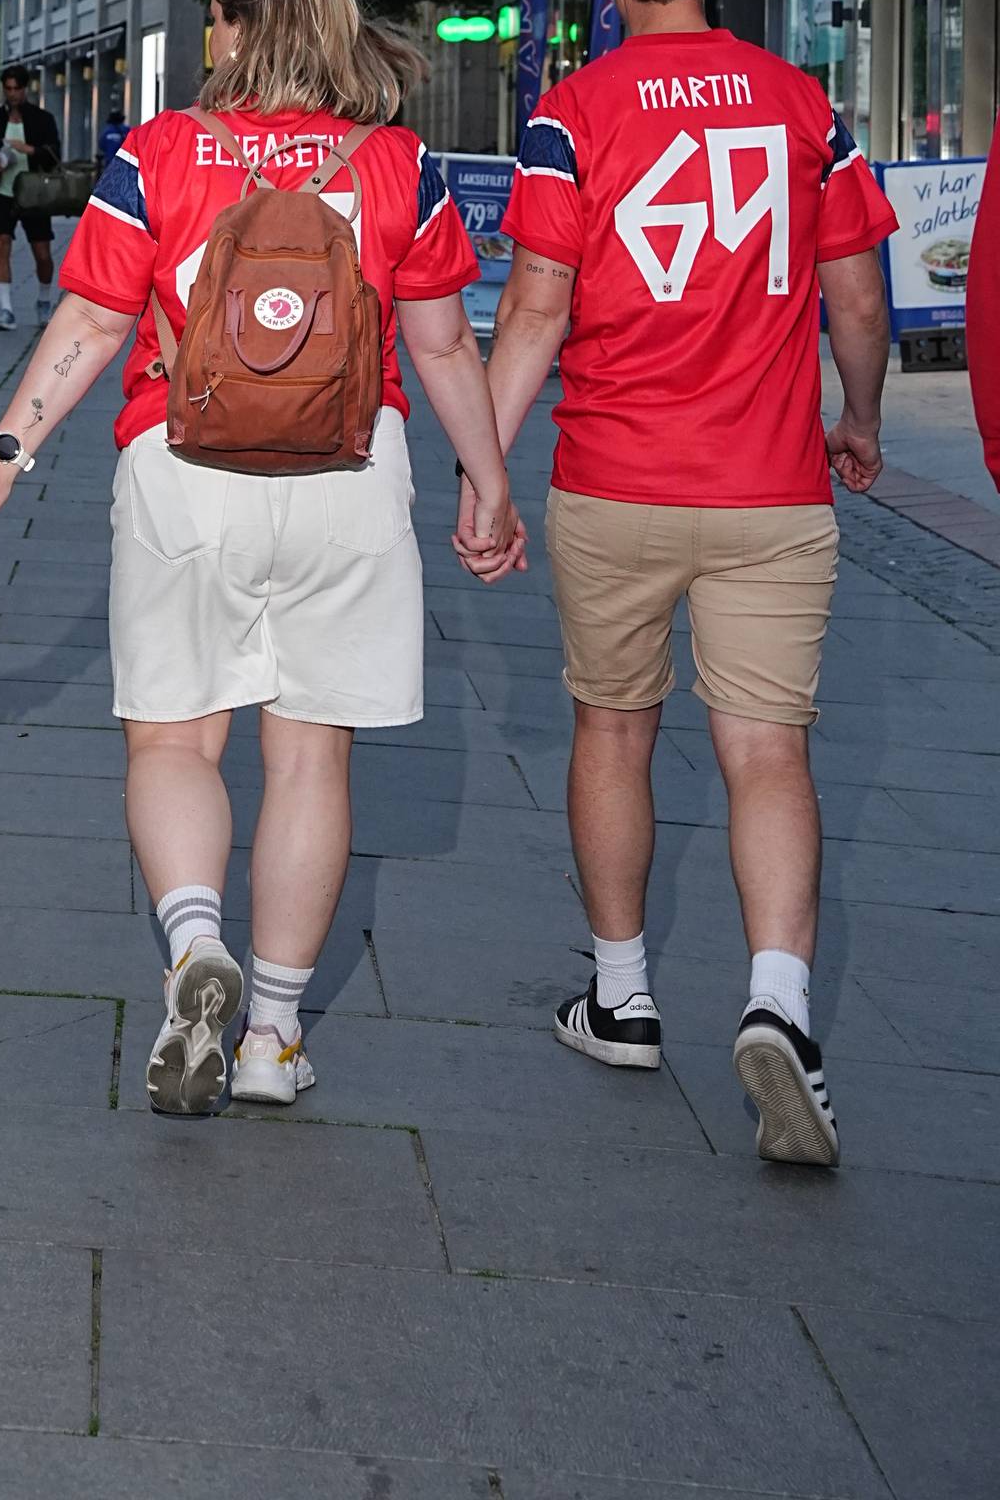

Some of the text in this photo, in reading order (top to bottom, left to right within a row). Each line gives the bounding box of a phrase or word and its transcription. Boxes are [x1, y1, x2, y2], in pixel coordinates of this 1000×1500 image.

[636, 73, 753, 111] MARTIN
[940, 170, 976, 195] har
[614, 124, 790, 303] 69
[912, 196, 981, 240] salatba
[552, 267, 569, 279] tre
[629, 1003, 655, 1011] adidas
